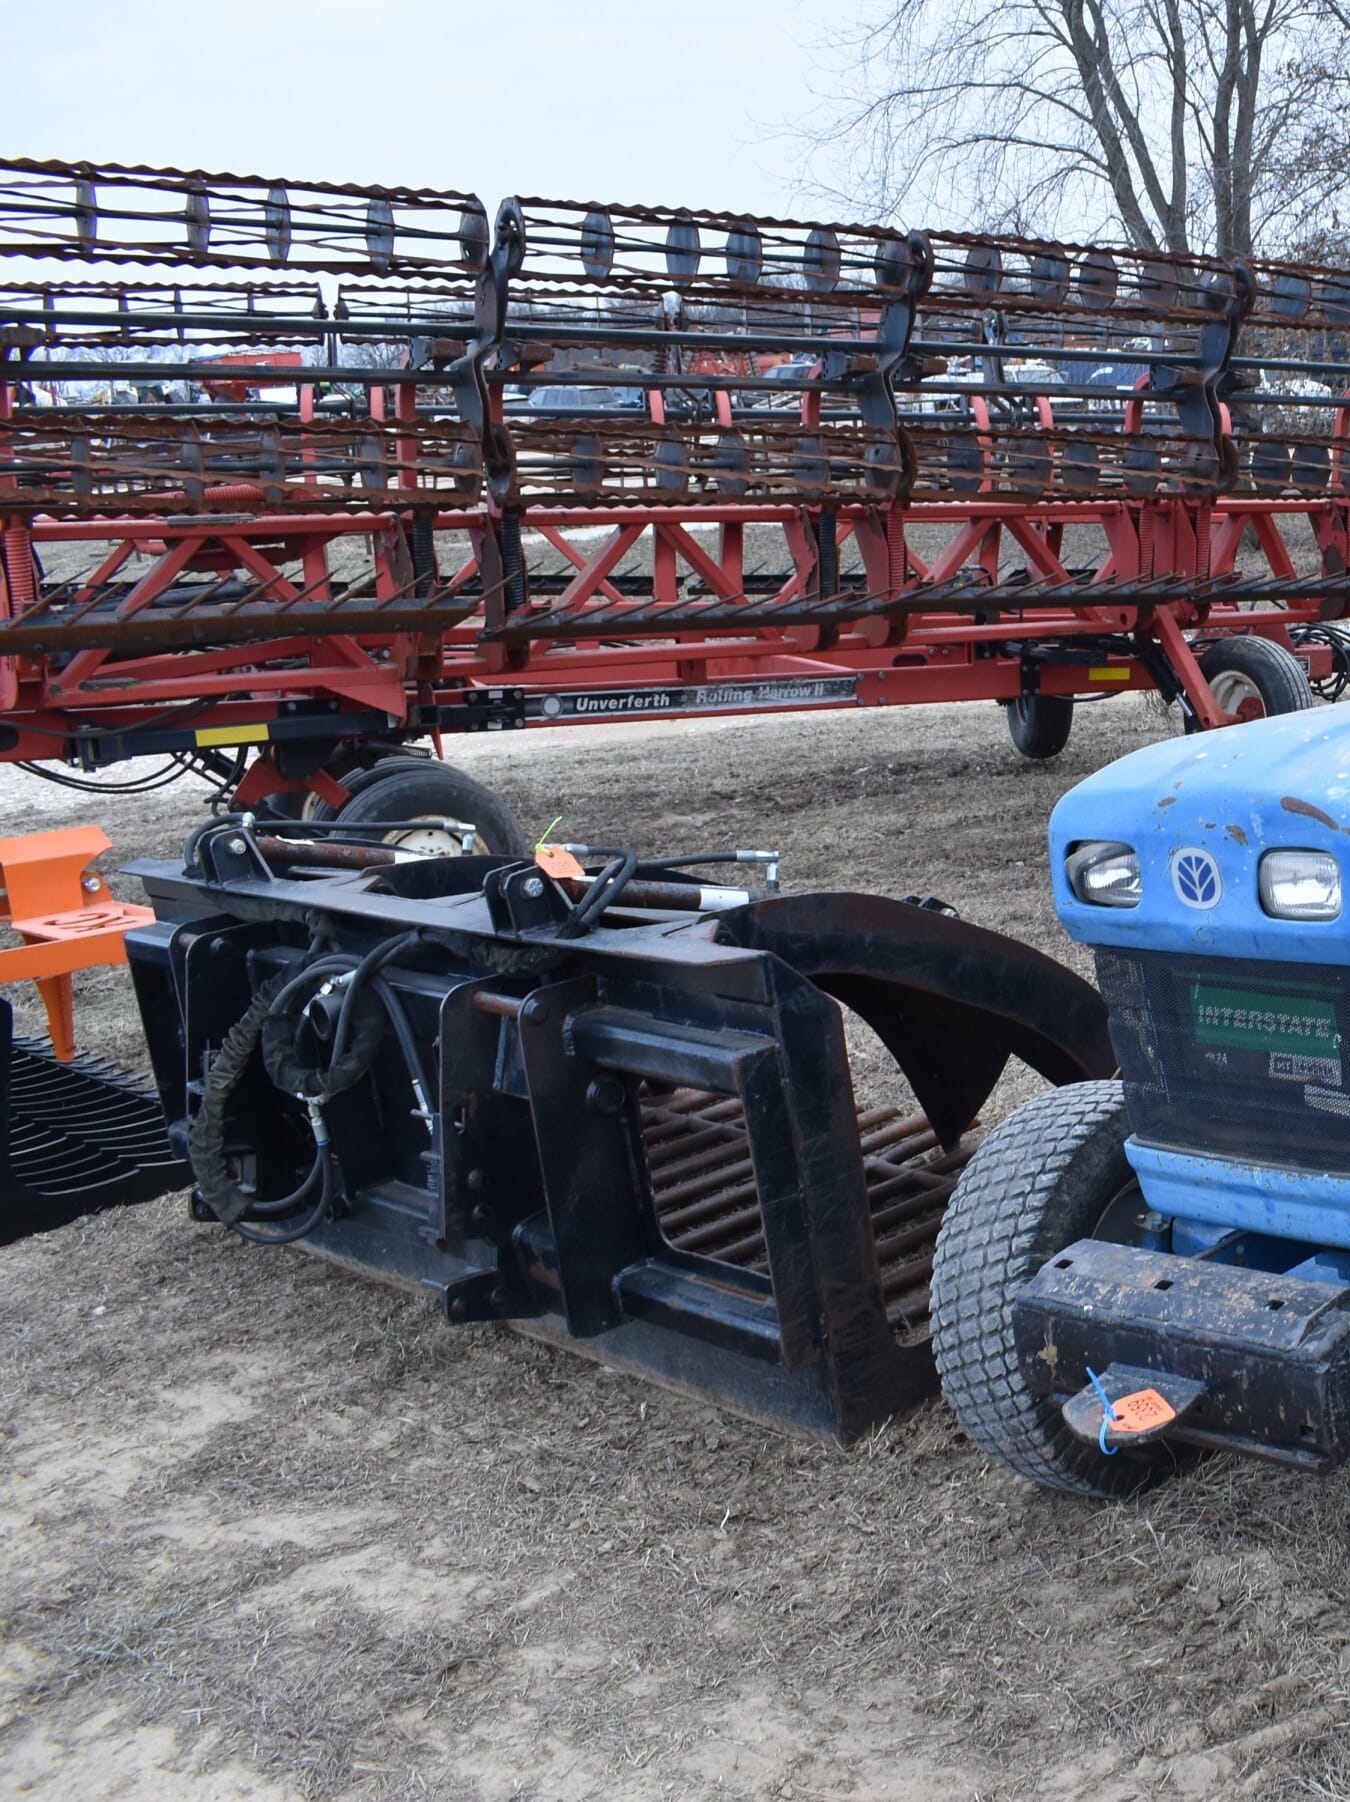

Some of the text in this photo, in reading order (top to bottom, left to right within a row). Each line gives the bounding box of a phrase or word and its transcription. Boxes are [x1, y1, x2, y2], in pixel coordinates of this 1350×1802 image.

[576, 693, 670, 711] Unverferth
[696, 688, 753, 703] Rolling
[758, 685, 811, 699] Harrow
[1198, 1004, 1332, 1039] INTERSTATE
